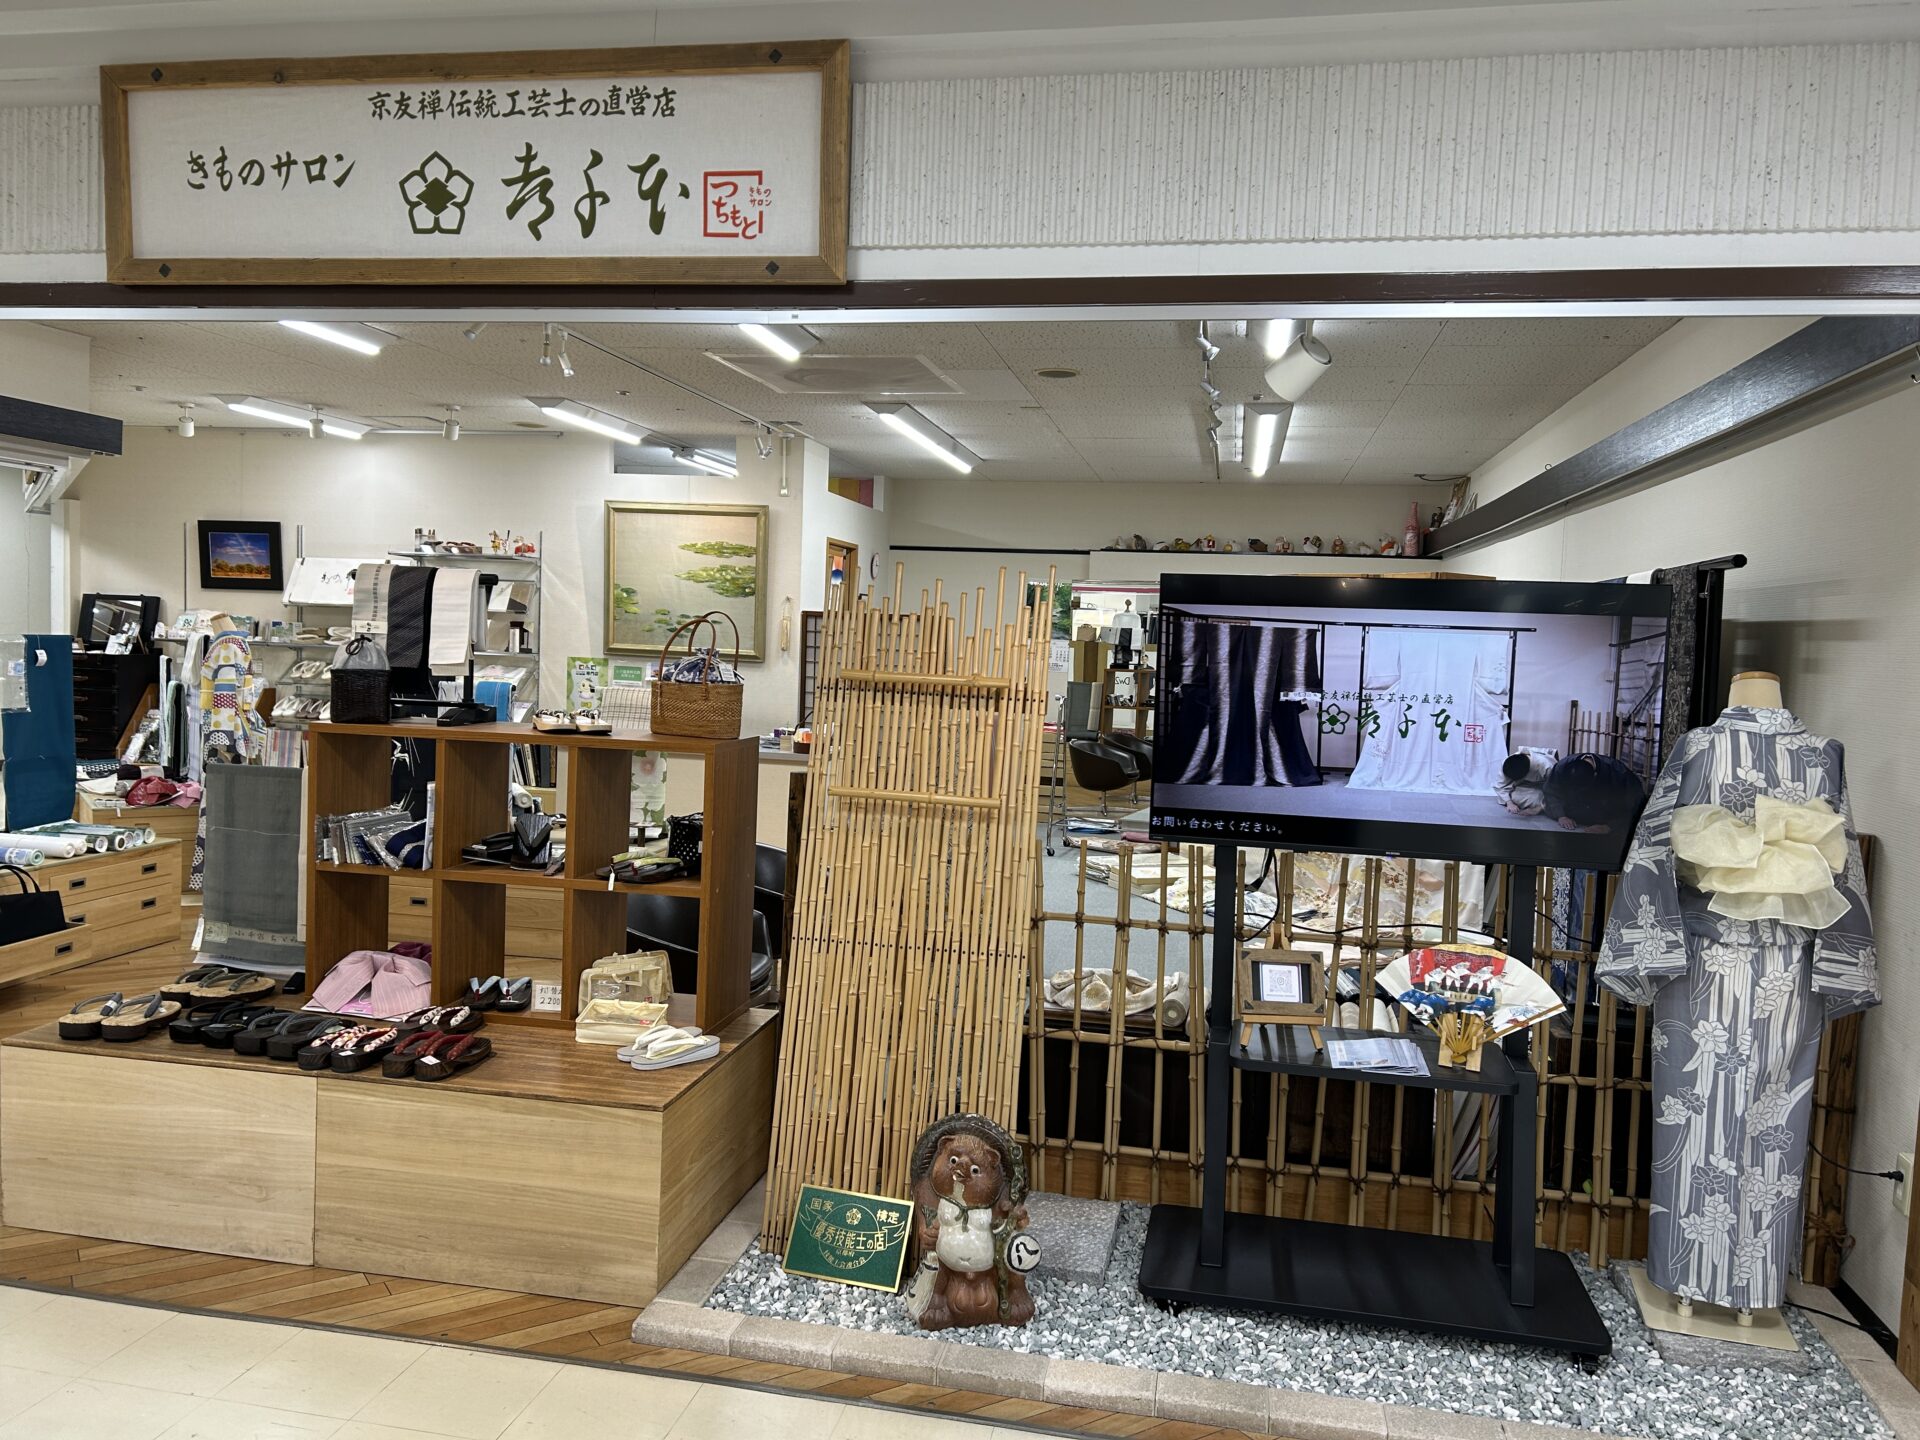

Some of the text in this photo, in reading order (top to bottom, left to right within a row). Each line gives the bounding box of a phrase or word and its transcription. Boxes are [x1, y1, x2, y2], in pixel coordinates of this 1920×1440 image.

[367, 85, 677, 121] 京友禅伝統工芸士の直営店
[187, 145, 356, 192] きものサロン
[749, 187, 772, 198] きもの
[749, 198, 772, 208] サロン
[710, 181, 757, 240] つちもと
[1152, 815, 1283, 835] お問い合わせください。
[810, 1197, 900, 1225] 国家 検定
[813, 1221, 885, 1251] 優秀技能士の店
